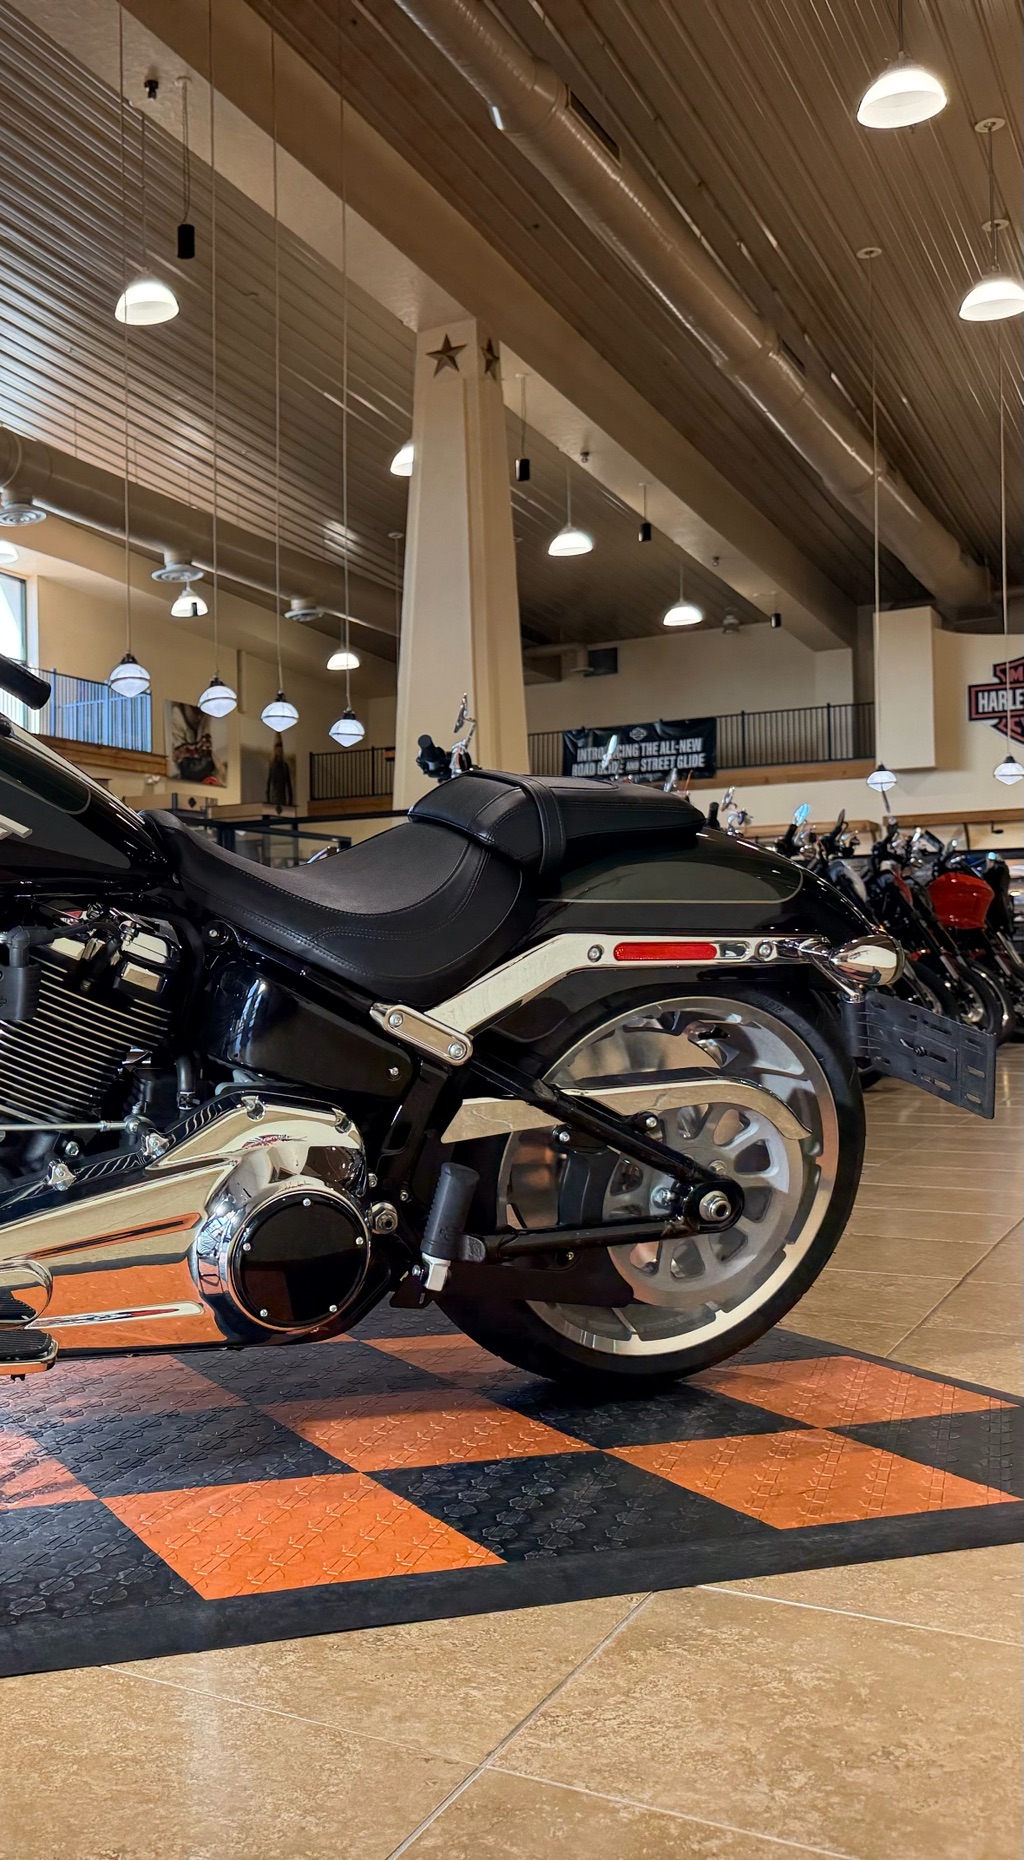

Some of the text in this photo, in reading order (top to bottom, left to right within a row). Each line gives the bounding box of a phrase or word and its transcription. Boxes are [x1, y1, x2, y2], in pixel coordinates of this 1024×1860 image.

[577, 737, 702, 762] INTROCING THE ALL-NEW
[572, 763, 595, 777] ROAD
[626, 762, 640, 771] AND
[641, 756, 676, 772] STREET
[676, 753, 706, 769] GLIDE
